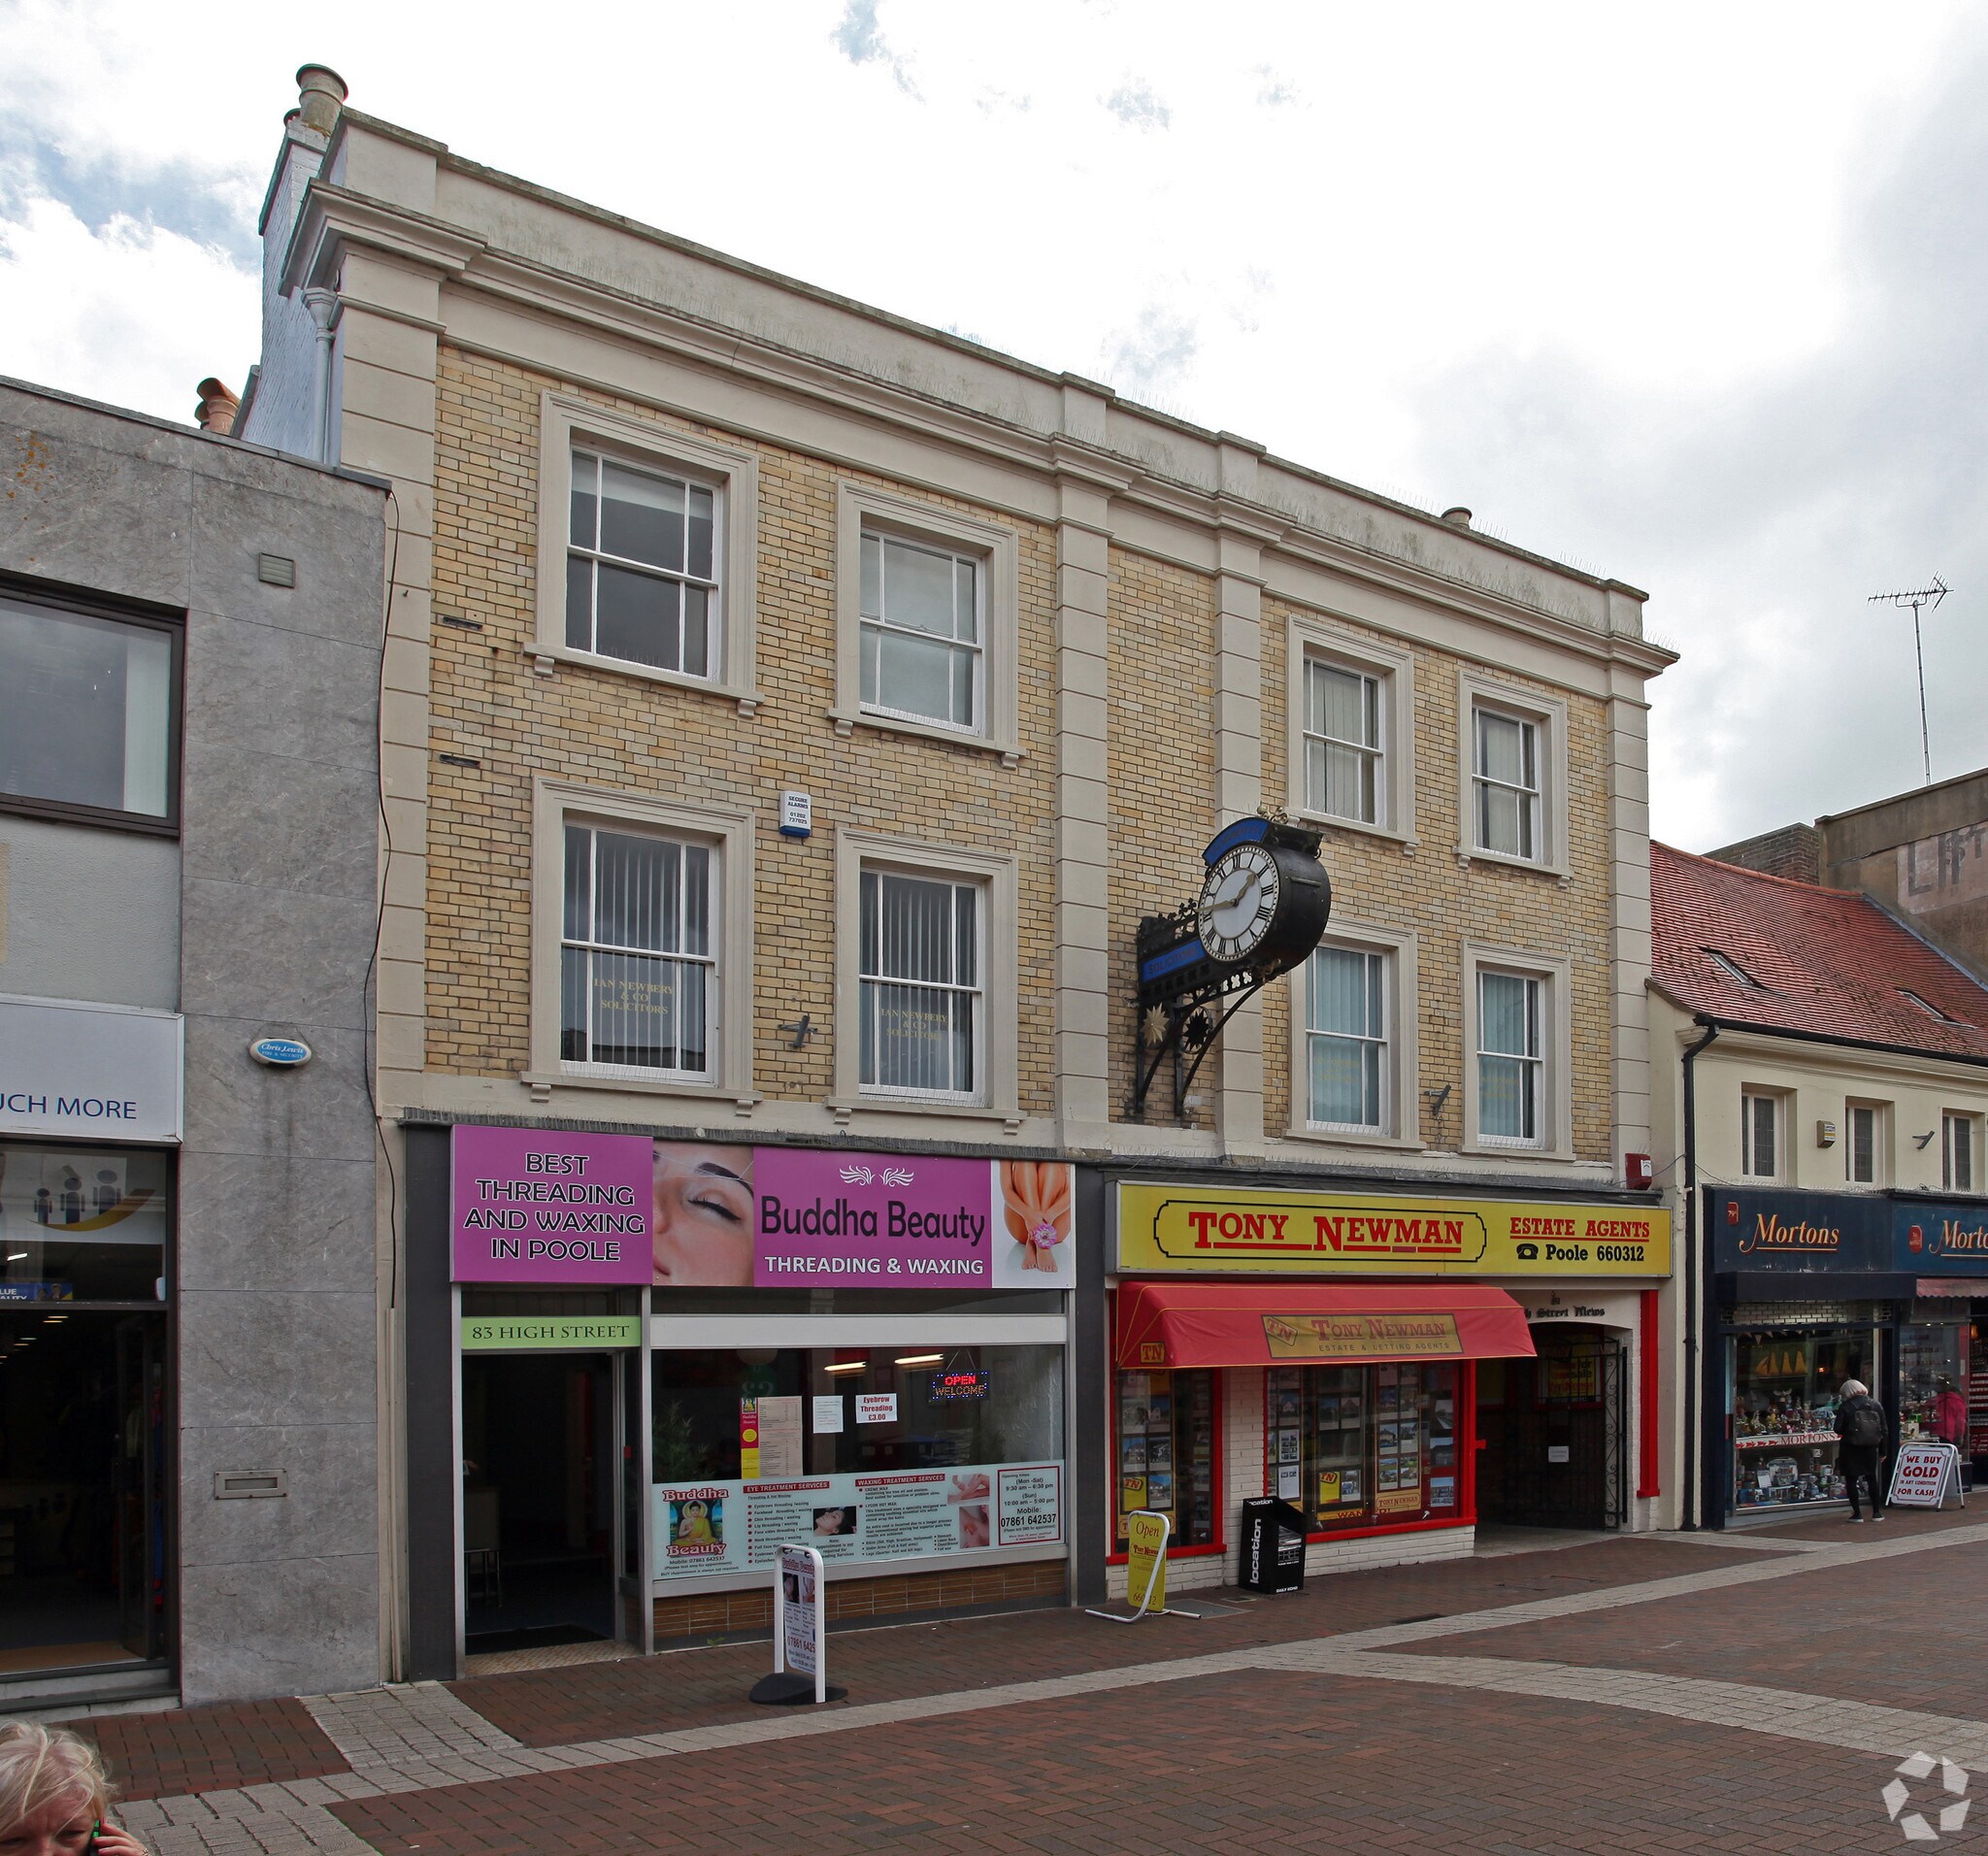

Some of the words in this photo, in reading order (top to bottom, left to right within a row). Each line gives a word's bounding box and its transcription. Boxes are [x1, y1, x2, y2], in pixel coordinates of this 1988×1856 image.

[594, 978, 615, 988] IAN
[619, 981, 674, 994] NEWBERY
[621, 992, 629, 1000] &
[633, 993, 649, 1002] CO
[601, 999, 668, 1015] SOLICITORS
[57, 1097, 137, 1119] MORE
[525, 1152, 589, 1175] BEST
[475, 1178, 634, 1206] THREADING
[463, 1207, 528, 1230] AND
[535, 1211, 645, 1234] WAXING
[761, 1195, 877, 1236] Buddha
[888, 1200, 985, 1246] Beauty
[1510, 1217, 1575, 1236] ESTATE
[1586, 1220, 1650, 1238] AGENTS
[1189, 1211, 1289, 1249] TONY
[1313, 1216, 1464, 1251] NEWMAN
[1739, 1214, 1839, 1253] Mortons
[491, 1238, 520, 1259] IN
[528, 1239, 620, 1262] POOLE
[1546, 1244, 1588, 1260] Poole
[1597, 1245, 1644, 1261] 660312
[765, 1256, 881, 1274] THREADING
[886, 1258, 901, 1274] &
[907, 1259, 984, 1275] WAXING
[472, 1327, 493, 1339] 83
[499, 1327, 554, 1338] HIGH
[561, 1326, 630, 1339] STREET
[1267, 1318, 1293, 1341] TN
[1311, 1320, 1362, 1341] TONY
[1365, 1319, 1445, 1339] NEWMAN
[1143, 1345, 1163, 1360] TN
[945, 1375, 976, 1385] OPEN
[935, 1385, 984, 1396] WELCOME
[1781, 1433, 1836, 1445] MORTONS
[1321, 1473, 1335, 1482] TN
[1902, 1466, 1939, 1478] GOLD
[1124, 1479, 1139, 1489] TN
[663, 1488, 729, 1502] Buddha
[1394, 1496, 1418, 1506] NEWMAN
[1001, 1516, 1025, 1527] 07861
[1028, 1515, 1056, 1525] 642537
[1136, 1521, 1159, 1538] Open
[666, 1543, 726, 1557] Beauty
[1250, 1518, 1261, 1584] location
[788, 1637, 802, 1649] 07861
